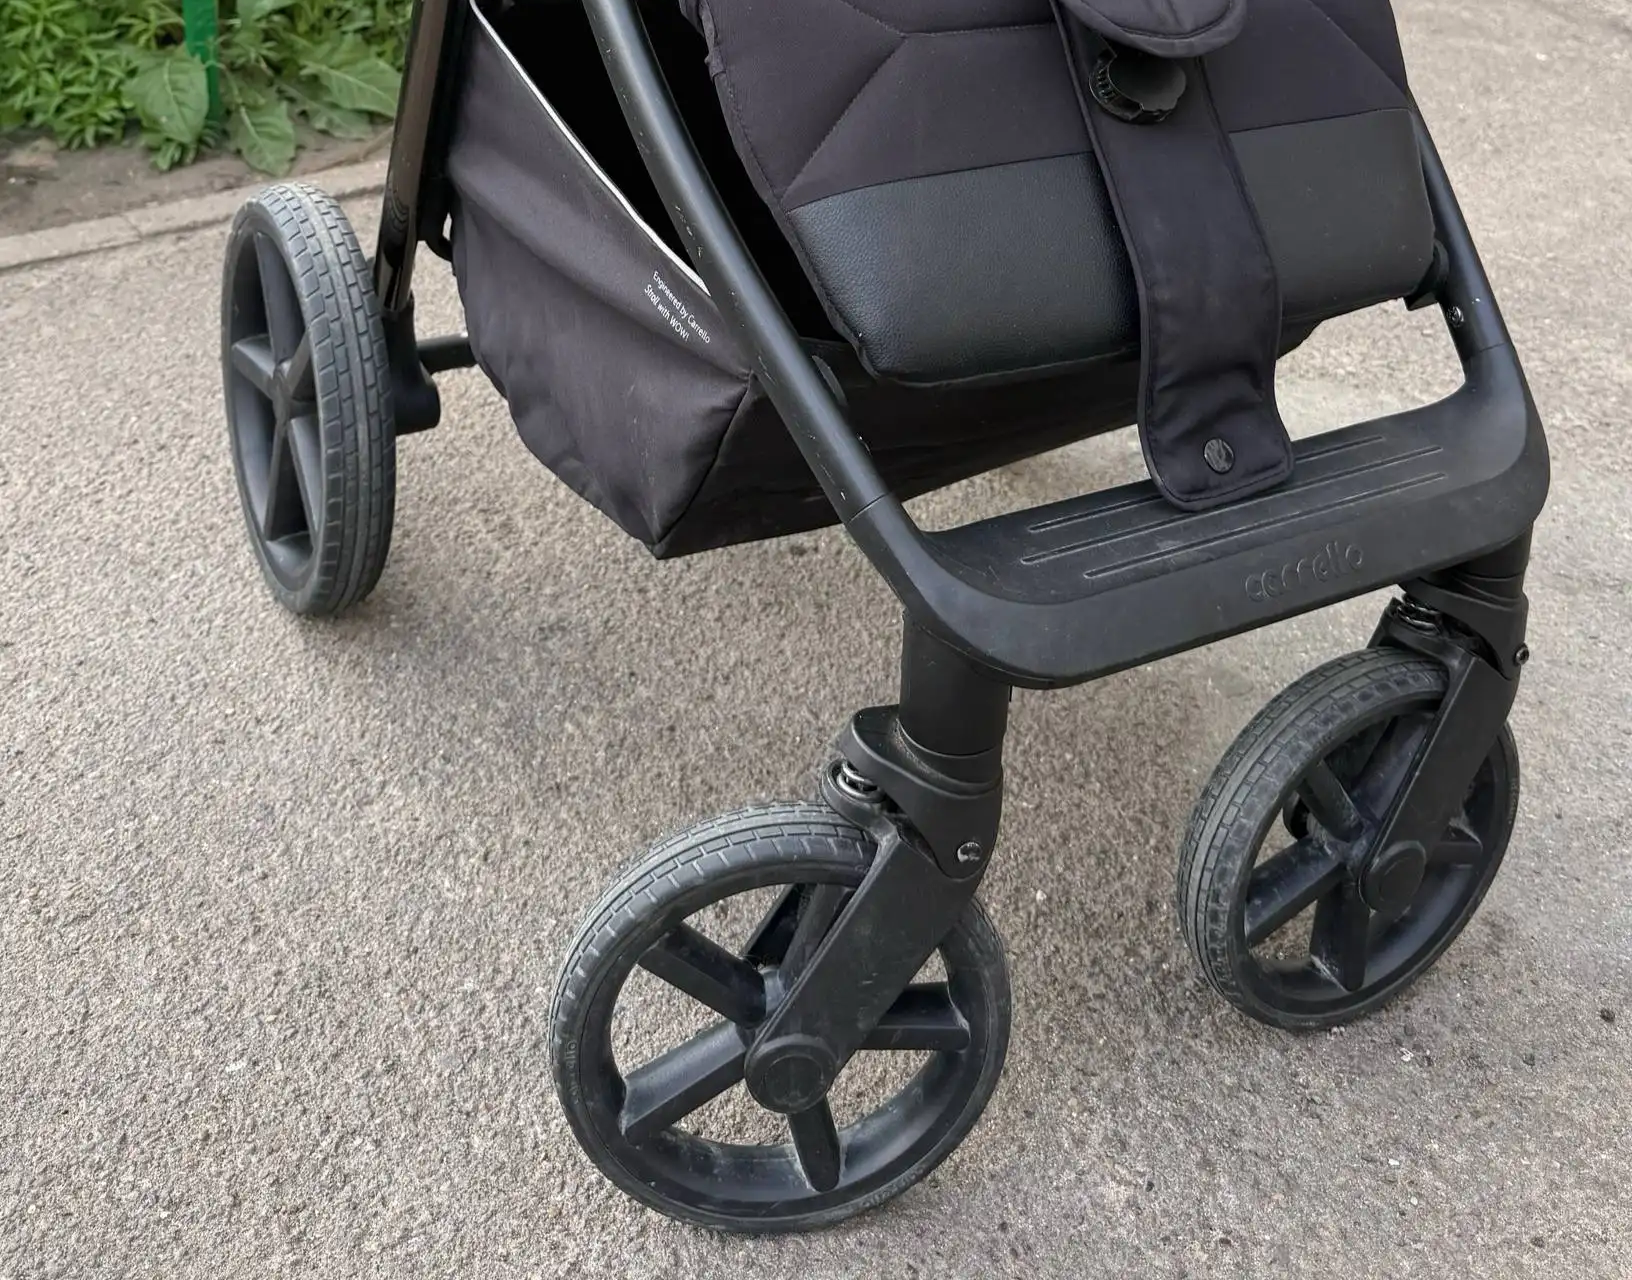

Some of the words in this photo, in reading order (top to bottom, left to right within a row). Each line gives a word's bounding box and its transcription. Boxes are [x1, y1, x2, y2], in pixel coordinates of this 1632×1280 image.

[644, 284, 661, 306] Stroll
[657, 304, 671, 320] with
[670, 315, 690, 342] WOW!
[653, 271, 682, 310] Engineered
[680, 305, 689, 319] by
[687, 314, 711, 344] Carrello
